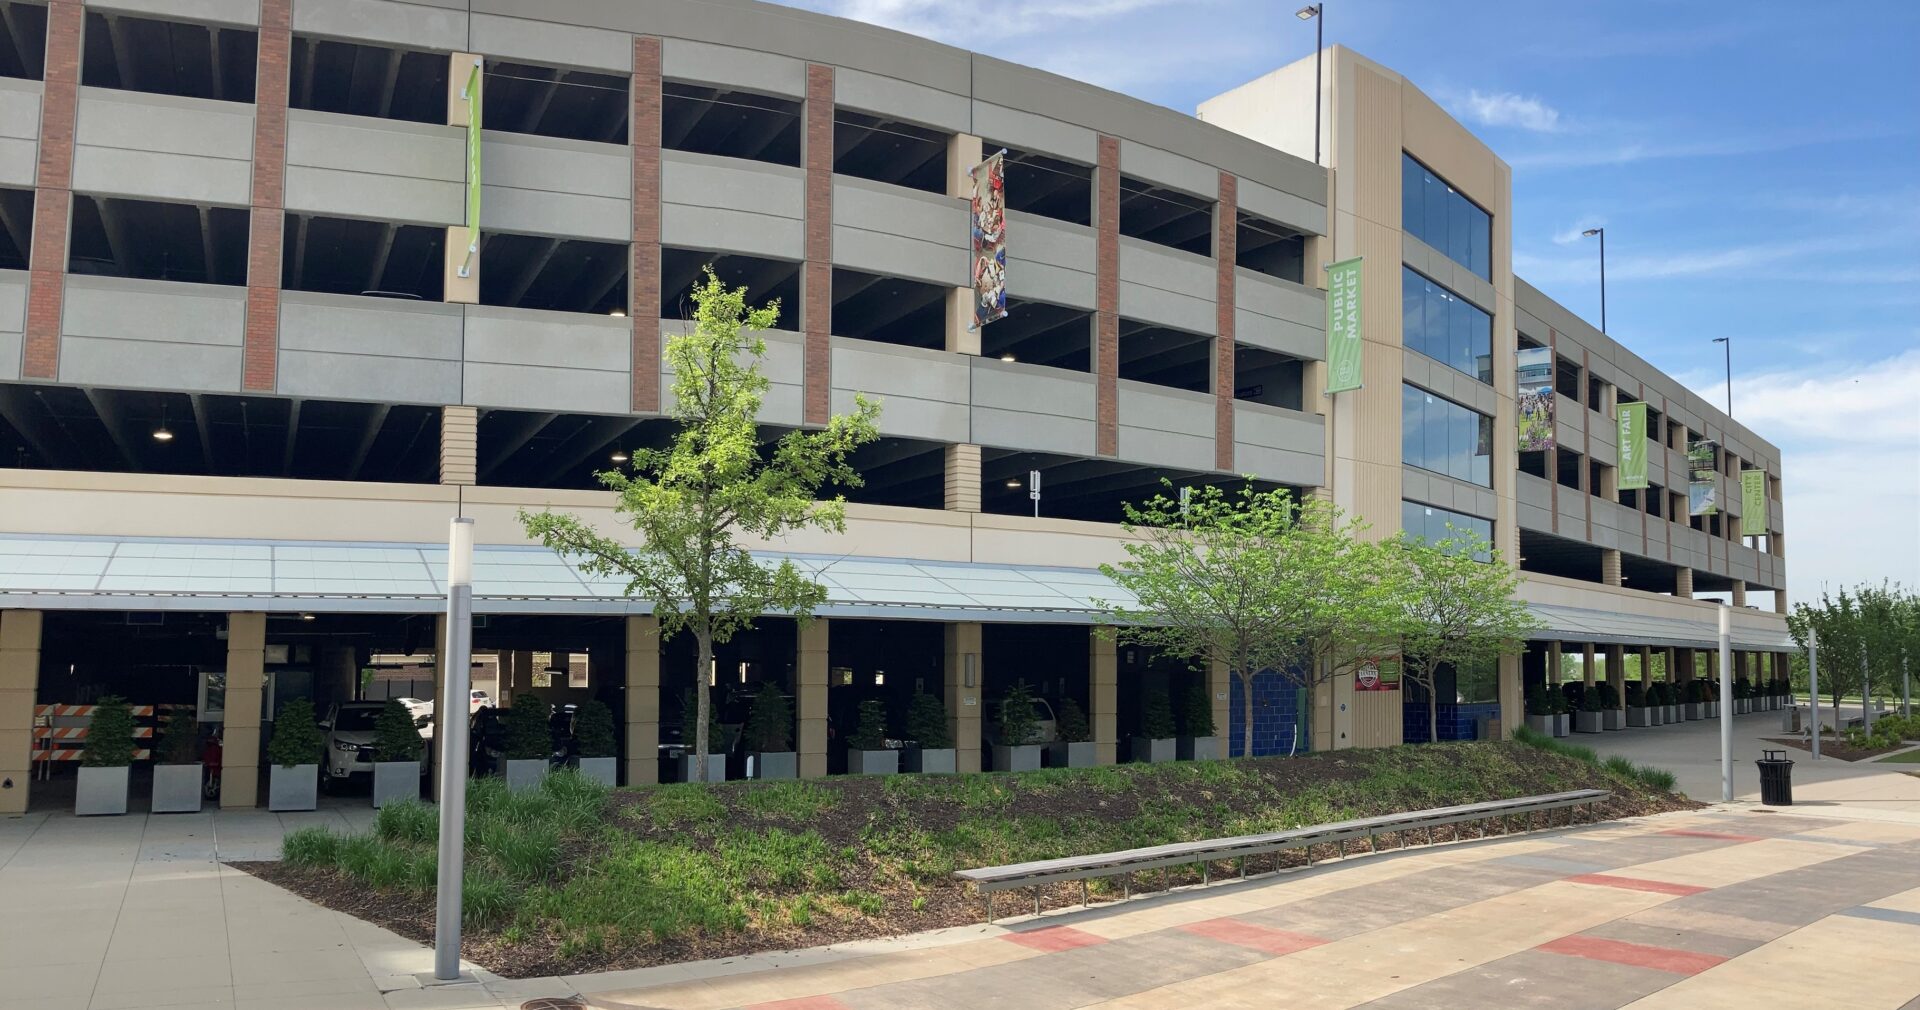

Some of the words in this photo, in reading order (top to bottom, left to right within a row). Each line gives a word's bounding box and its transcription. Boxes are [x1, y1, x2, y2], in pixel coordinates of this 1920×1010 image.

[1334, 271, 1344, 332] PUBLIC
[1346, 270, 1357, 338] MARKET
[1622, 410, 1631, 434] FAIR
[1623, 439, 1631, 461] ART
